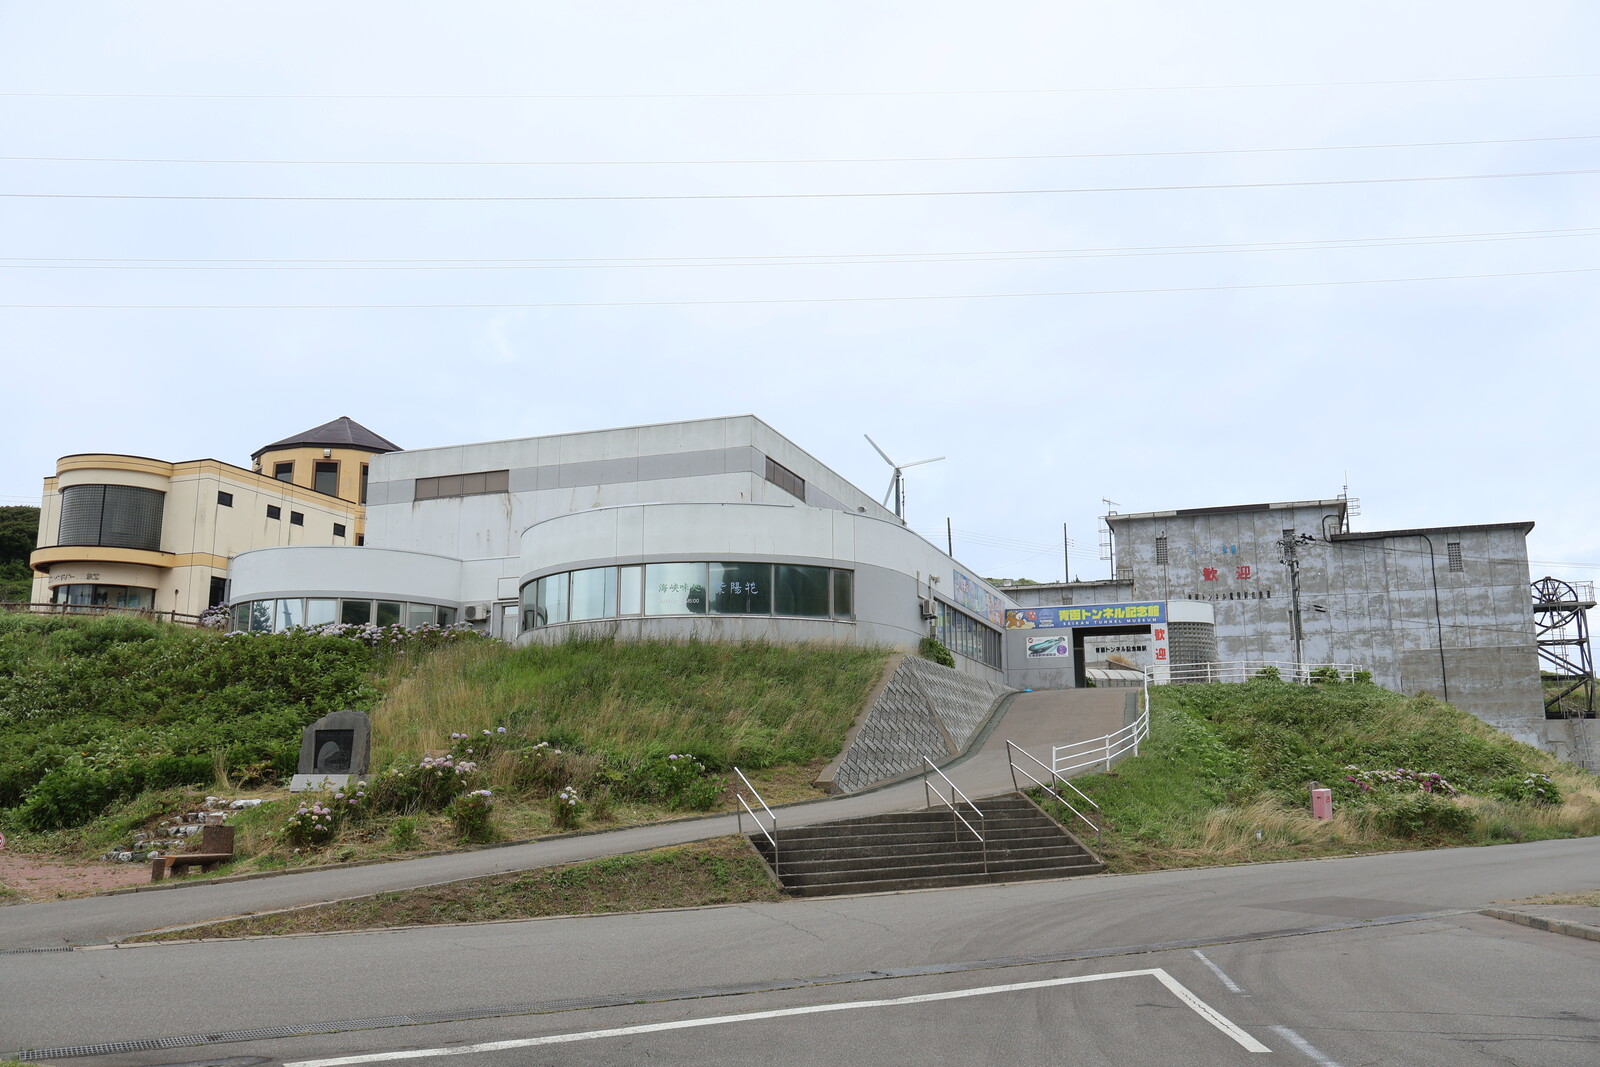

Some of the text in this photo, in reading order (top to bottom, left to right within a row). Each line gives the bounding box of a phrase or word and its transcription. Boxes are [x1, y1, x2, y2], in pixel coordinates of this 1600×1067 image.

[1202, 565, 1251, 581] 歓迎
[1058, 605, 1160, 621] 青函トンネル記念館
[1154, 628, 1167, 660] 歓迎
